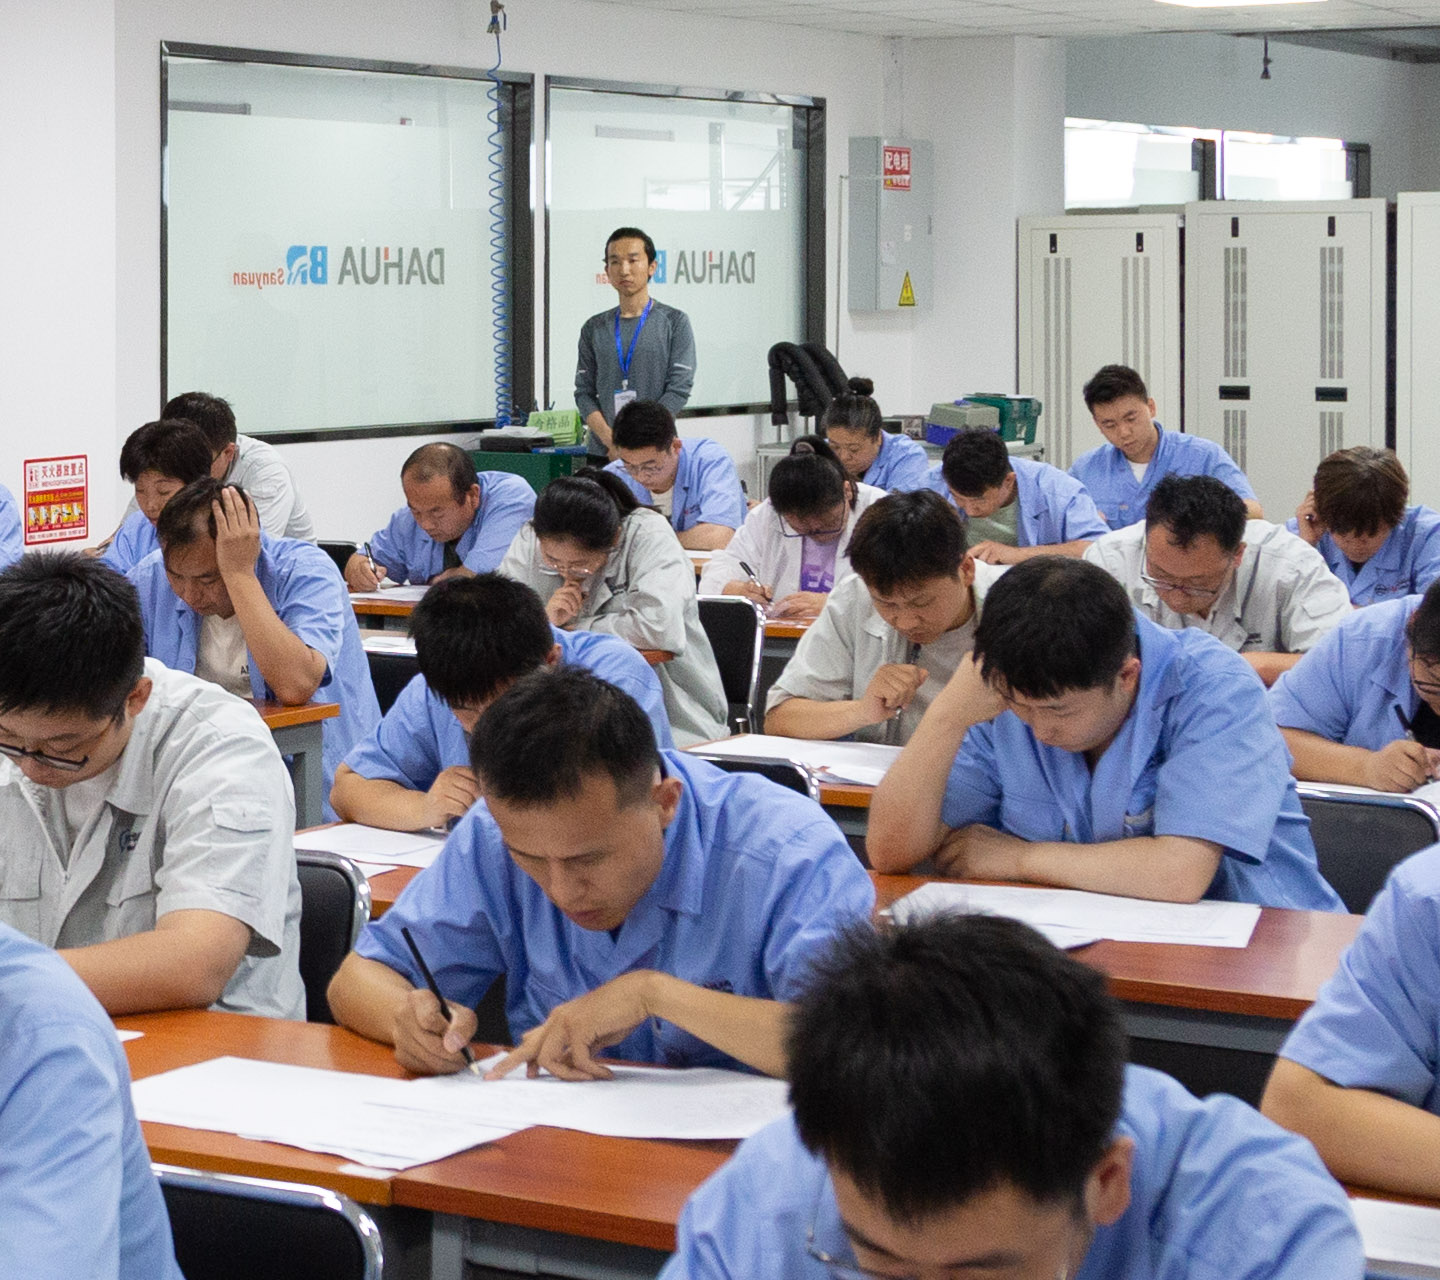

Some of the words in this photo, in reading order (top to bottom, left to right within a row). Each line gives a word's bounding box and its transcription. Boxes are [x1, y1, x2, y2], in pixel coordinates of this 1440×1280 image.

[42, 462, 84, 478] 灭火器放置点
